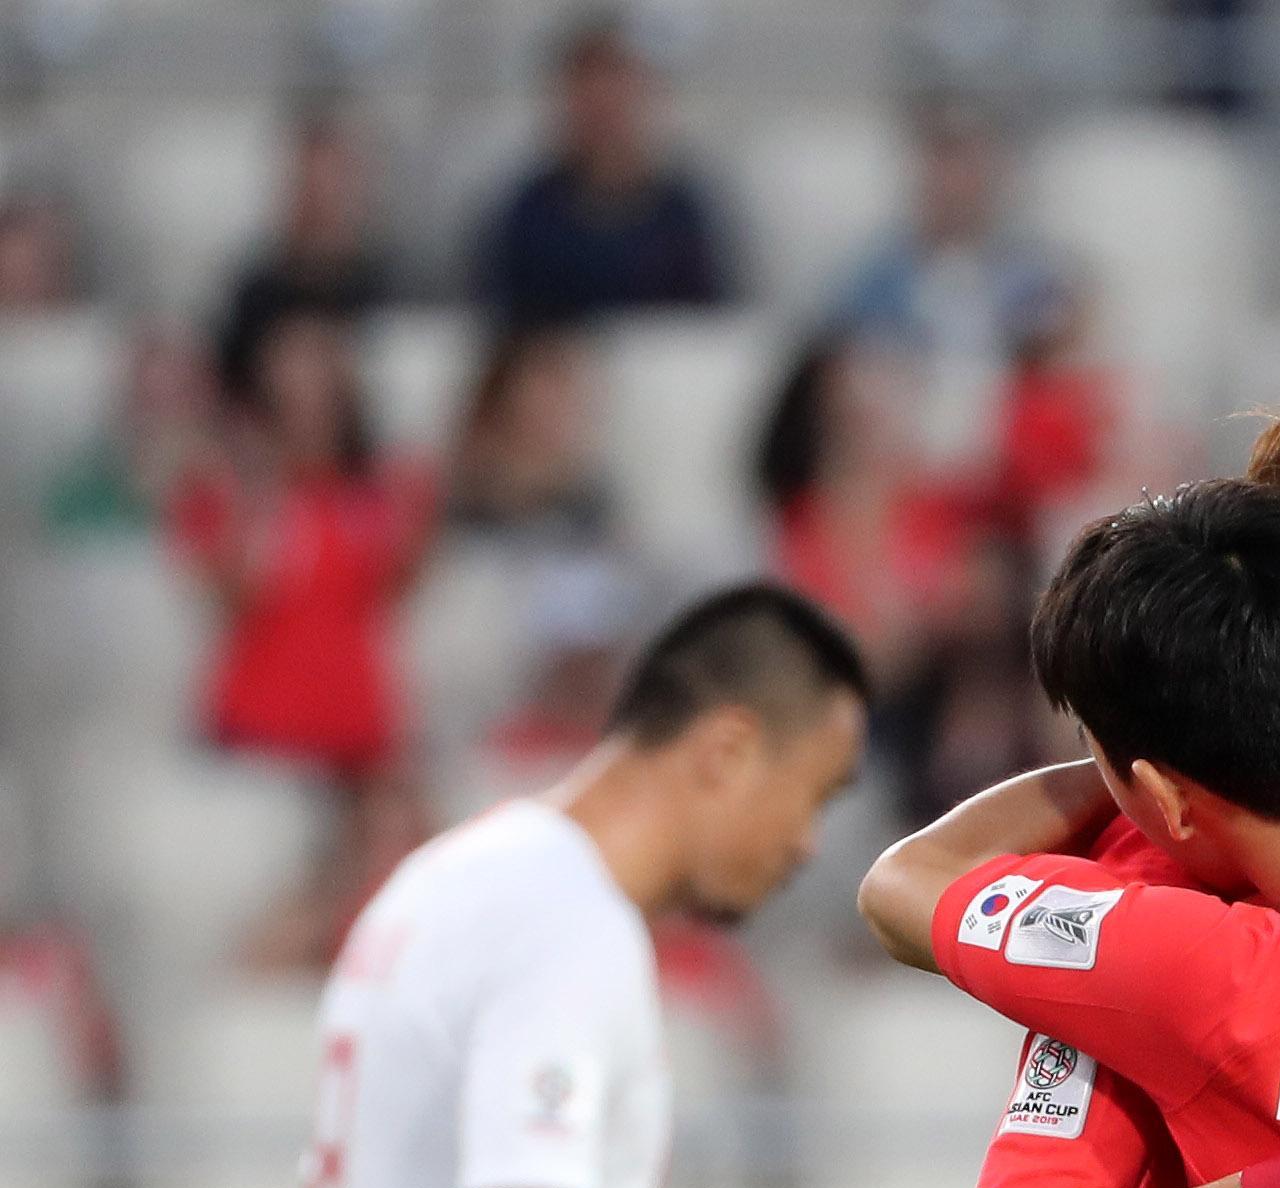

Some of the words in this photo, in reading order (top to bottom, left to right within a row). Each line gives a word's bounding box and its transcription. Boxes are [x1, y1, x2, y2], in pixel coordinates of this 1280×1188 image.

[1027, 1091, 1053, 1102] AFC
[1007, 1102, 1043, 1114] SIAN
[1045, 1103, 1079, 1117] CUP
